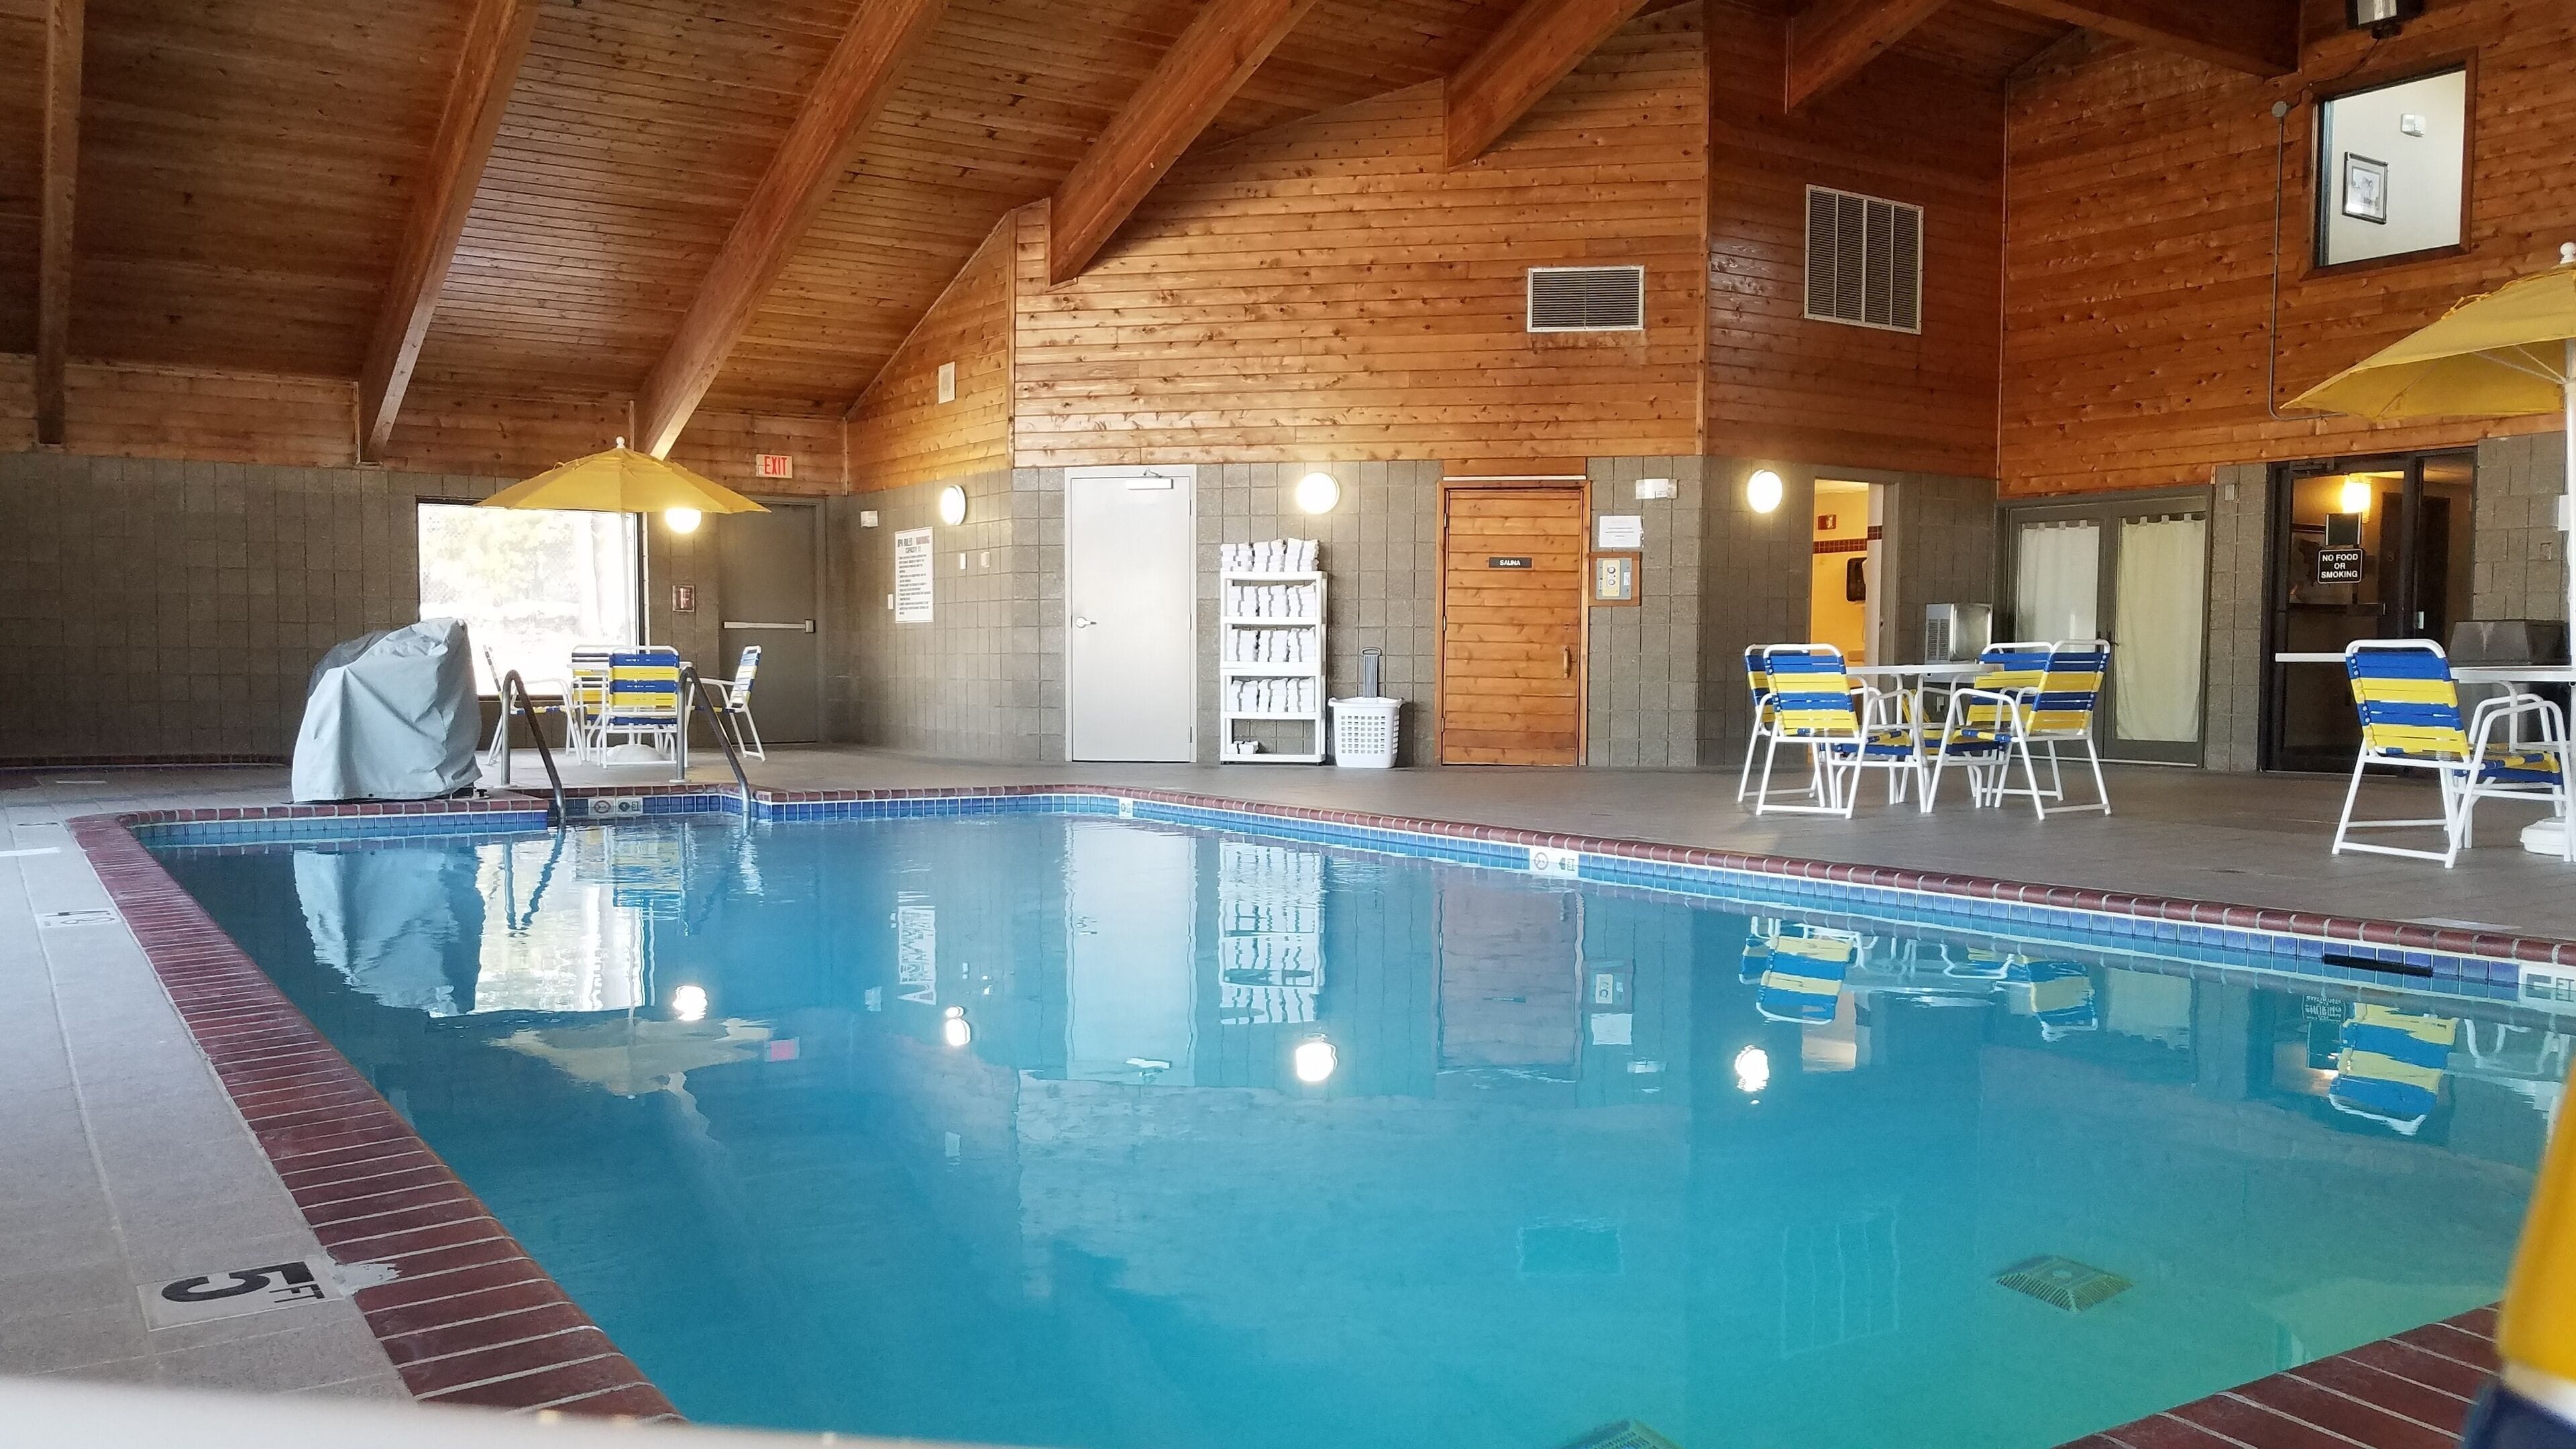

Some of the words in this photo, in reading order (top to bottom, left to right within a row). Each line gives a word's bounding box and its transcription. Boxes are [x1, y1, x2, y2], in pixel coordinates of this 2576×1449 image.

[764, 455, 787, 476] EXIT
[2336, 553, 2358, 561] FOOD
[2321, 570, 2358, 578] SMOKING
[162, 1261, 314, 1302] 5
[268, 1283, 325, 1303] FT
